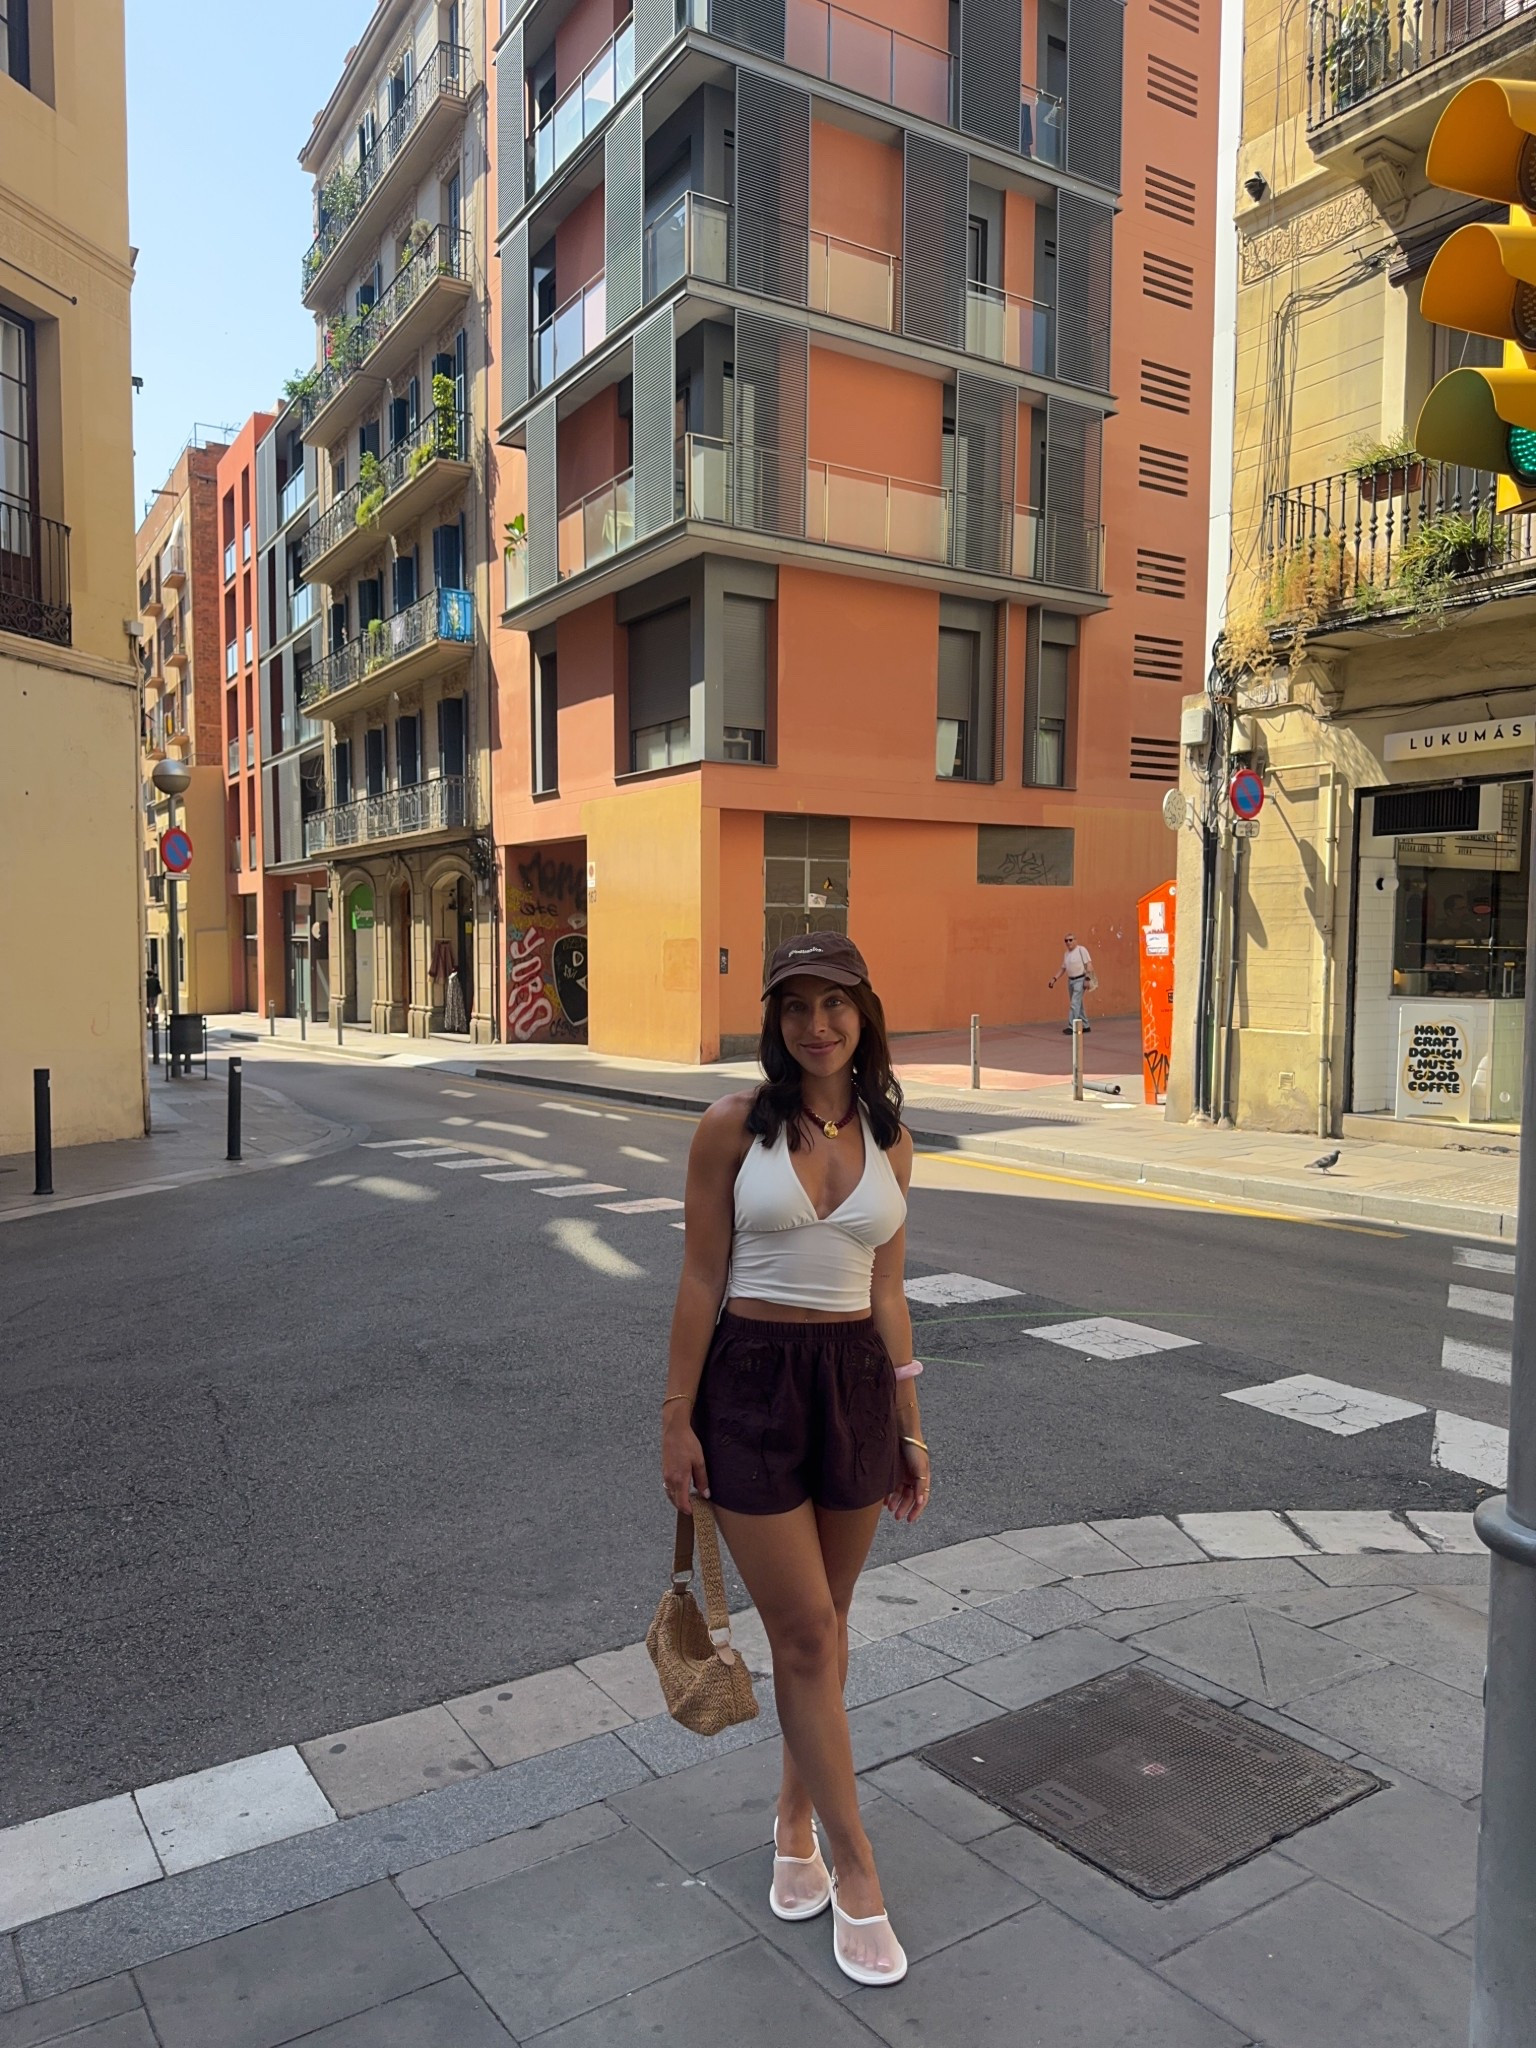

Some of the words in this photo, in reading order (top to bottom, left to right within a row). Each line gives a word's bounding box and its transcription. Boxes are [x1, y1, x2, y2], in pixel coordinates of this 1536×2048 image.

[1410, 724, 1522, 750] LUKUMÁS
[1414, 1025, 1456, 1037] HAND
[1413, 1036, 1459, 1048] CRAFT
[1409, 1047, 1462, 1060] DOUGH
[1417, 1059, 1455, 1070] NUTS
[1413, 1070, 1460, 1082] GOOD
[1408, 1081, 1460, 1094] COFFEE
